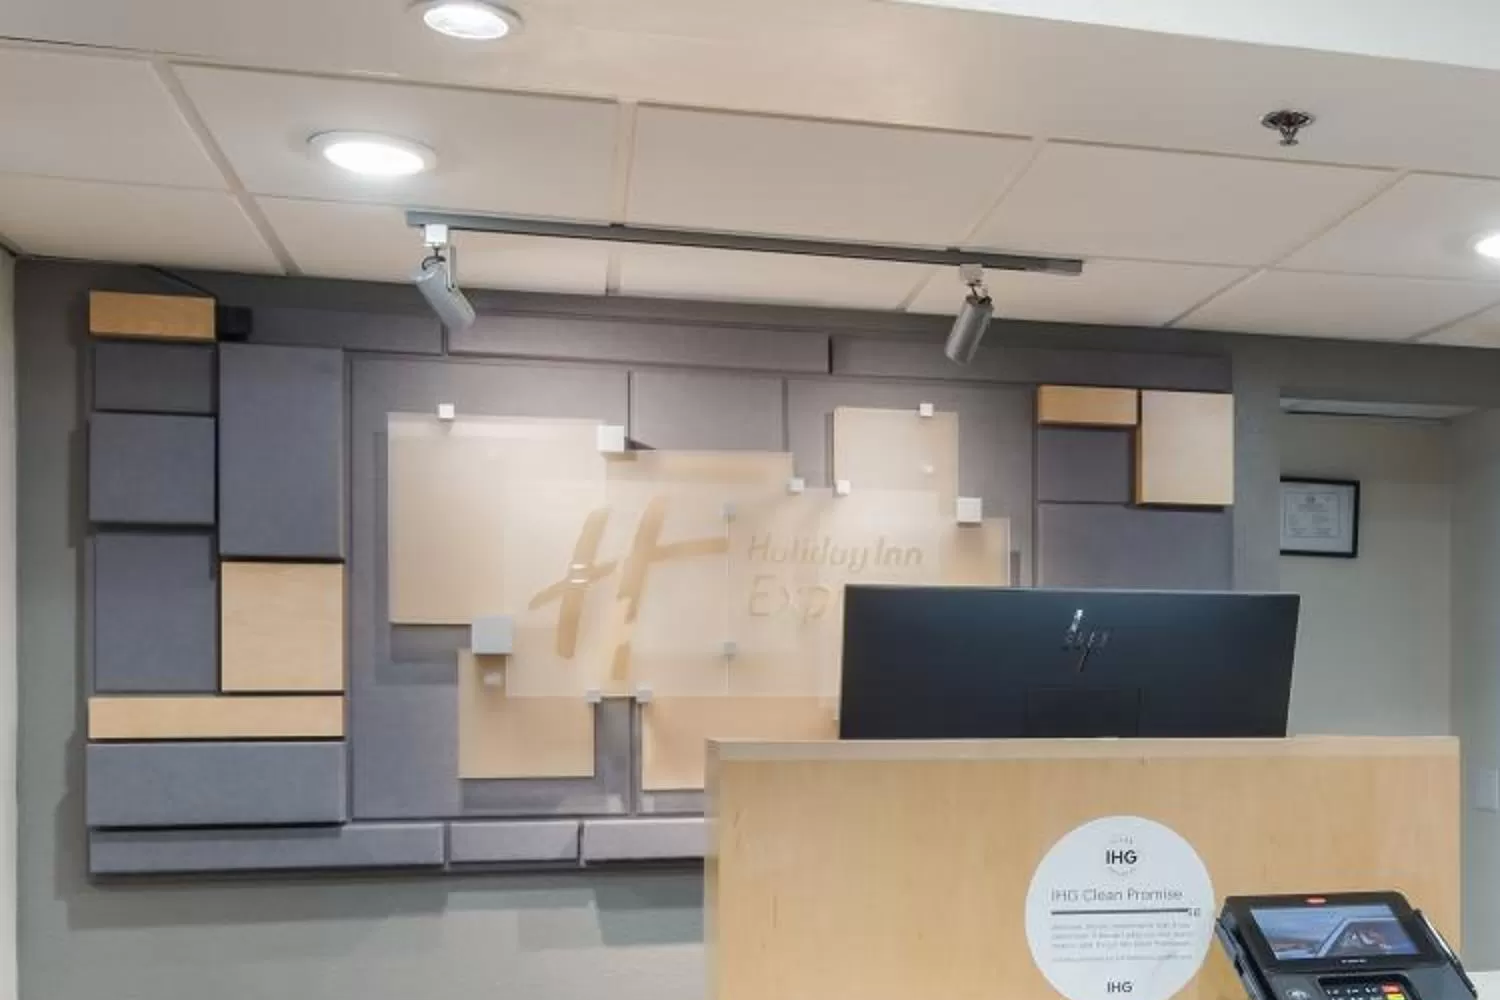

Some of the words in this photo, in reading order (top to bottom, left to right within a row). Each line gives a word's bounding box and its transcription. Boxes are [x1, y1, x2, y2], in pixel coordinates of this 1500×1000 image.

[748, 532, 868, 573] Holiday
[874, 536, 924, 565] Inn
[1105, 850, 1137, 865] IHG
[1051, 887, 1080, 902] IHG
[1082, 887, 1123, 901] Clean
[1127, 886, 1184, 901] Promise
[1107, 981, 1133, 993] IHG
